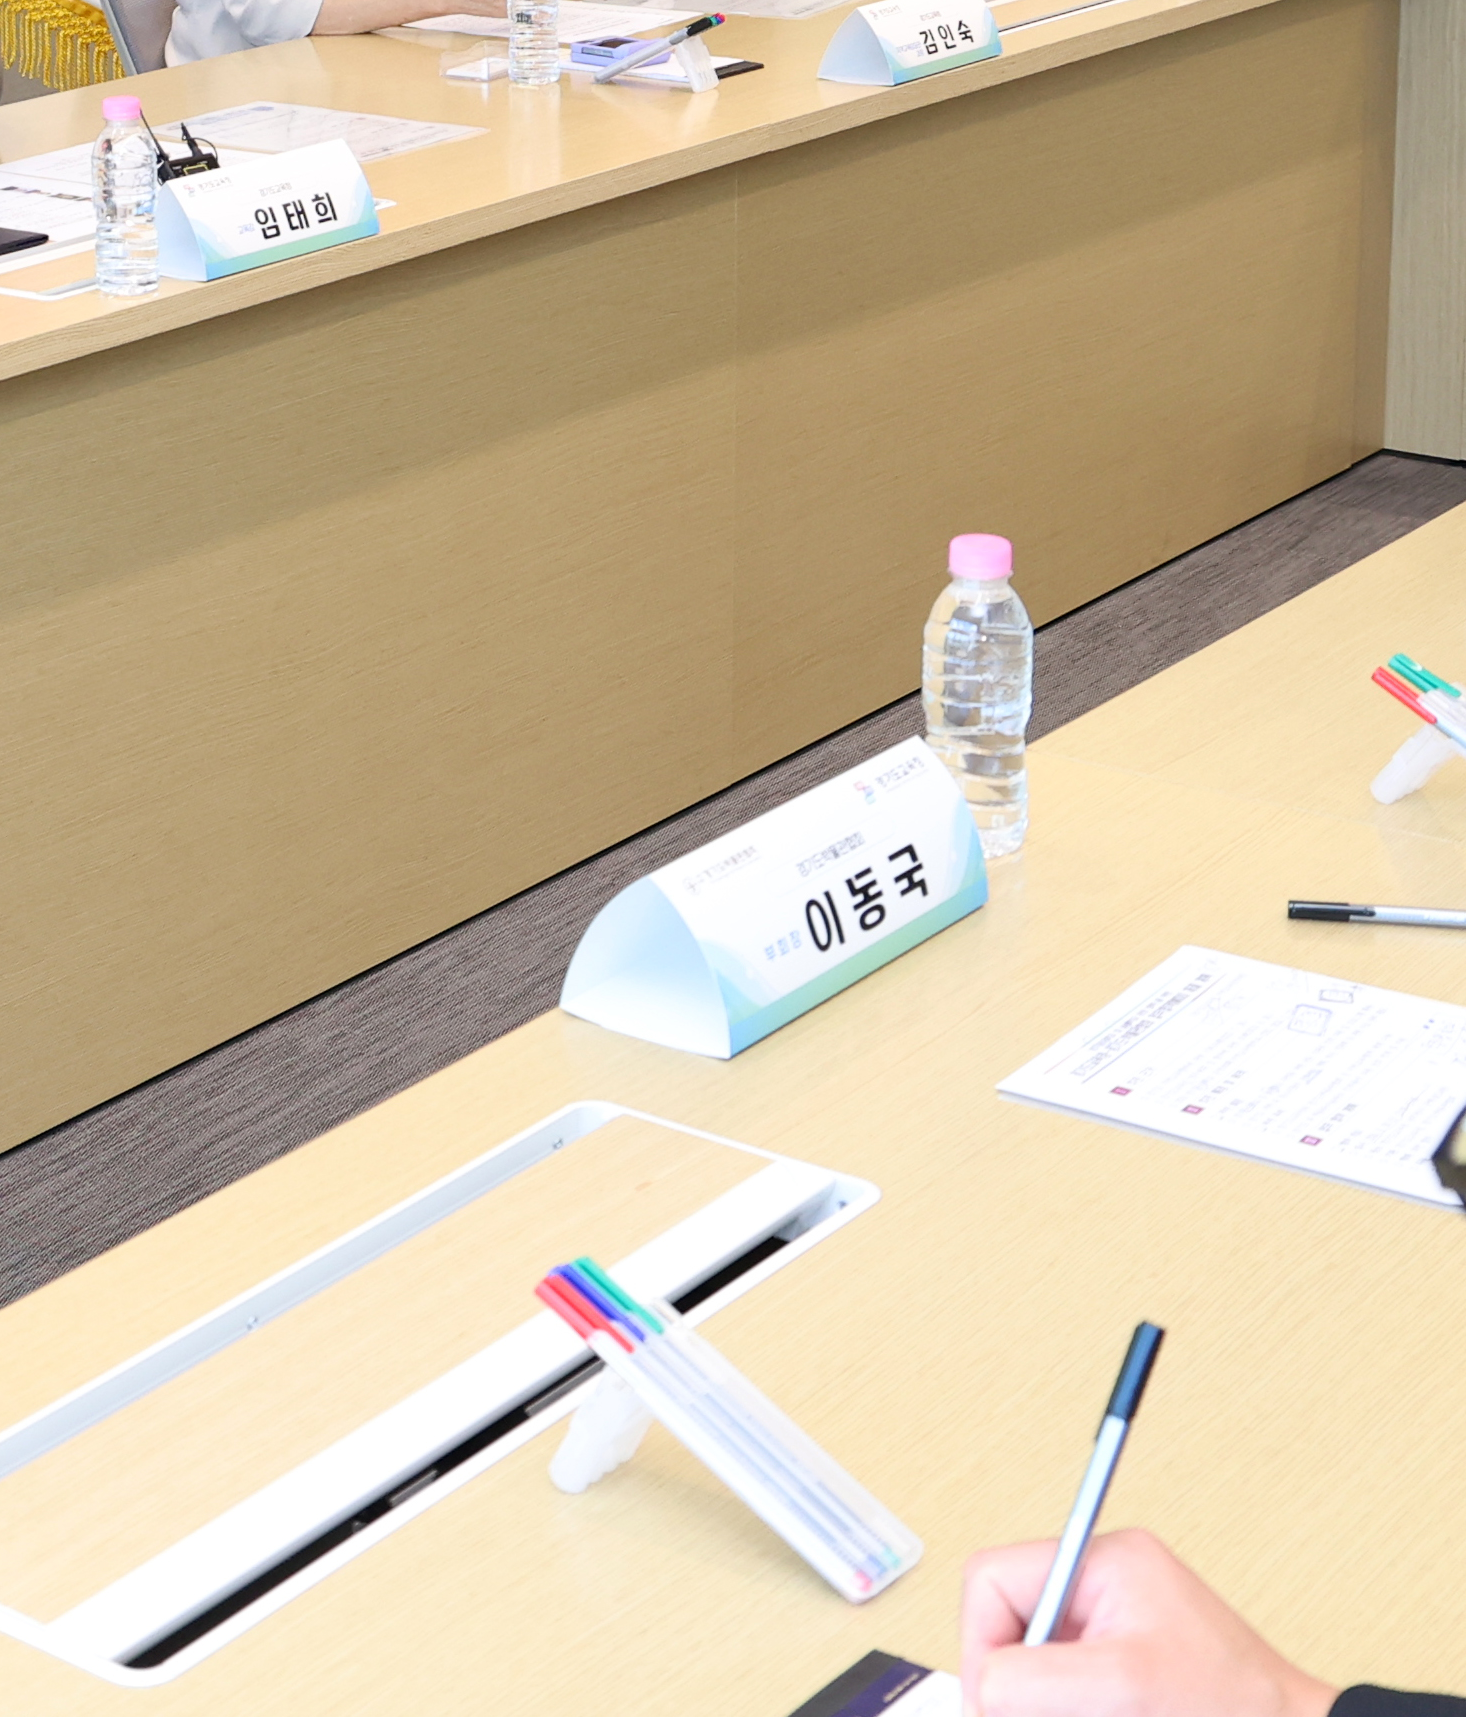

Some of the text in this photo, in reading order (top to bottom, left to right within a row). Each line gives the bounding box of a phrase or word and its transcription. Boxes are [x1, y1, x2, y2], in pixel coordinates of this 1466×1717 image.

[919, 19, 975, 55] 김인숙
[255, 193, 337, 239] 임태희
[805, 843, 930, 952] 이동국
